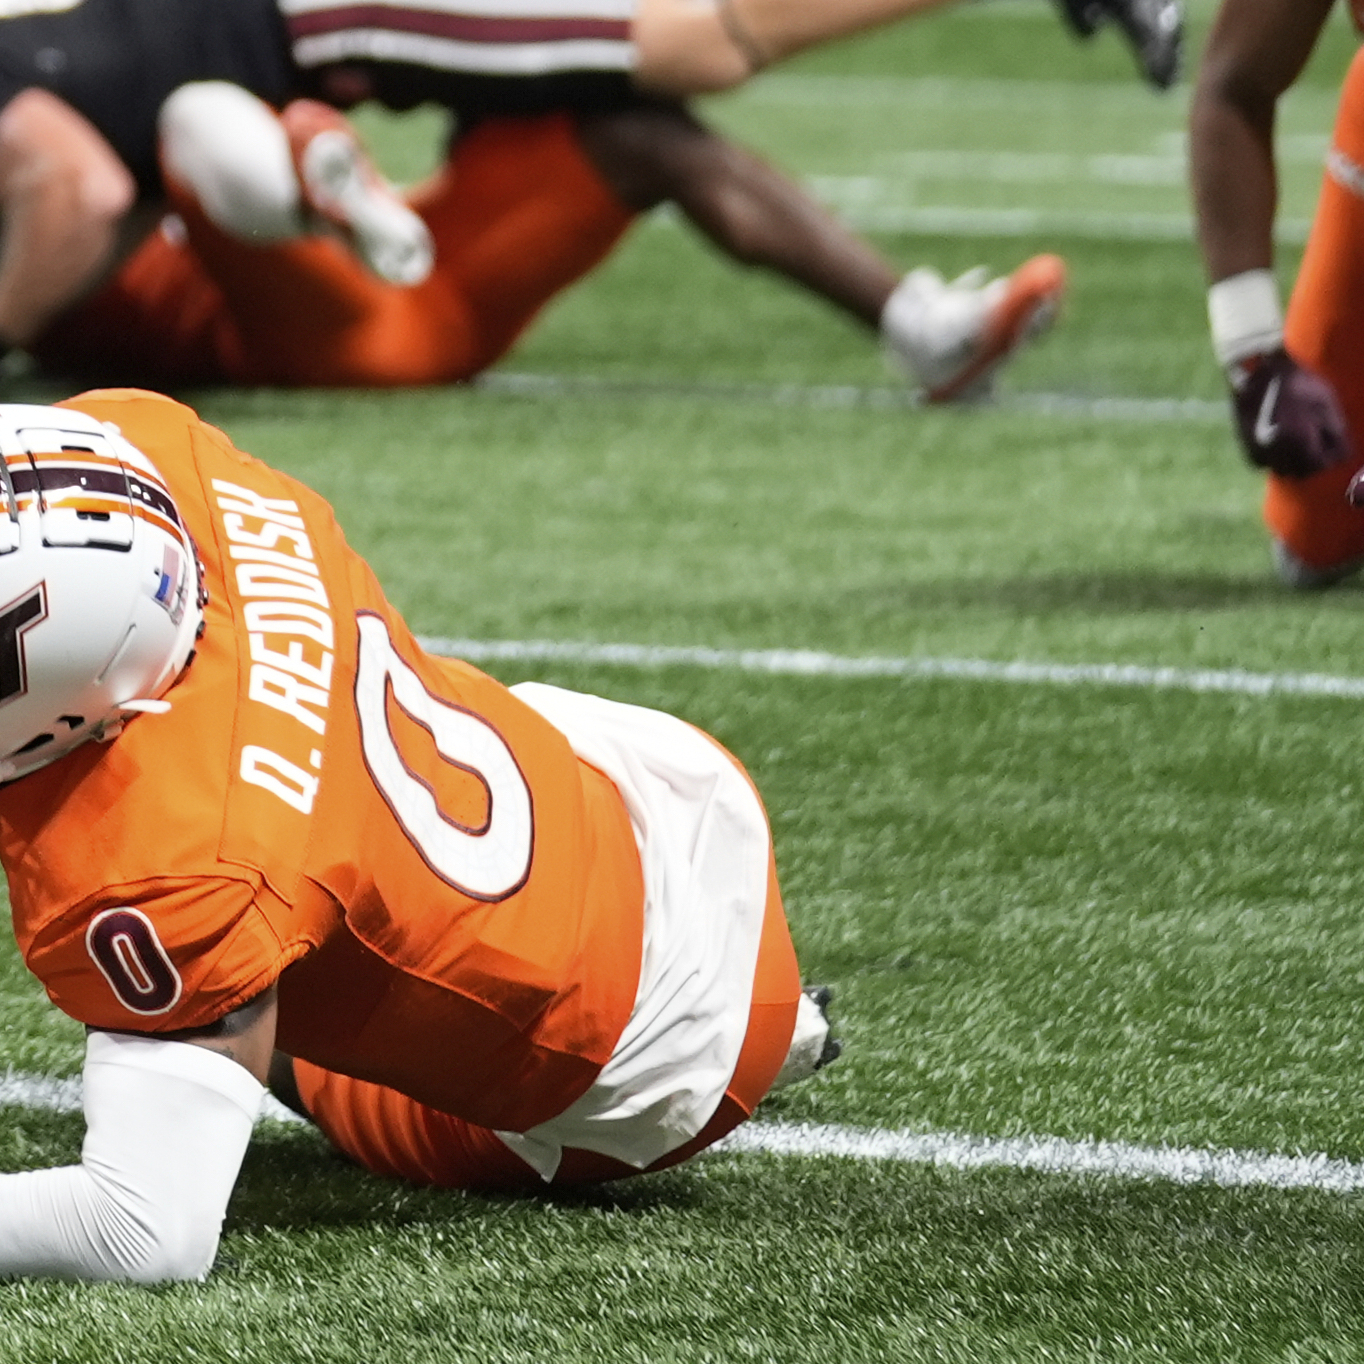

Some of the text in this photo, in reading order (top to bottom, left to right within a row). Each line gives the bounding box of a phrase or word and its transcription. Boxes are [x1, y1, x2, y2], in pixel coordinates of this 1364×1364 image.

[210, 477, 335, 736] REDDISH
[353, 608, 536, 904] 0
[85, 906, 183, 1016] 0
